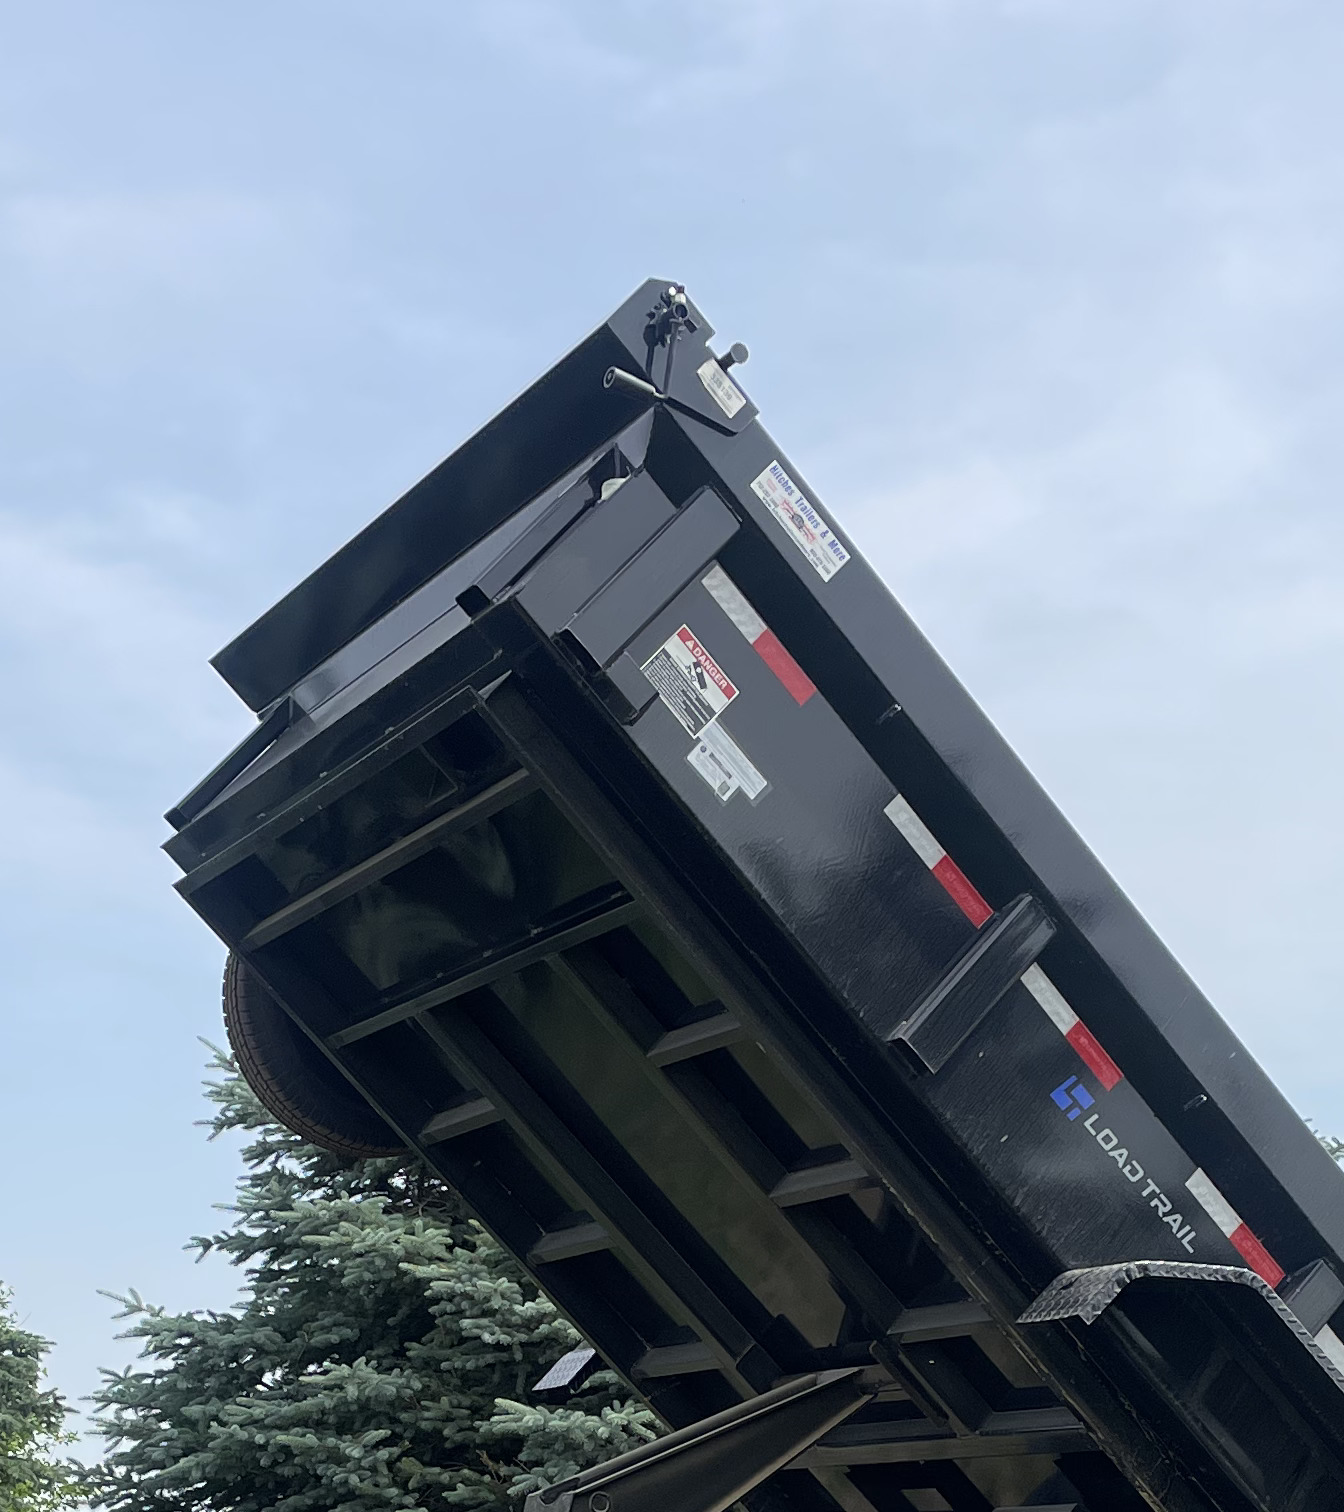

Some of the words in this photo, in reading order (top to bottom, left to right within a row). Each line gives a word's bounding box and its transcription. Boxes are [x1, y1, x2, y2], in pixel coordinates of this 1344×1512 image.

[769, 464, 796, 496] Hitches
[795, 497, 820, 529] Trailers
[820, 530, 830, 538] &
[828, 539, 846, 562] More
[692, 646, 728, 689] DANGER
[1083, 1113, 1145, 1183] LOAD
[1141, 1178, 1197, 1254] TRAIL
